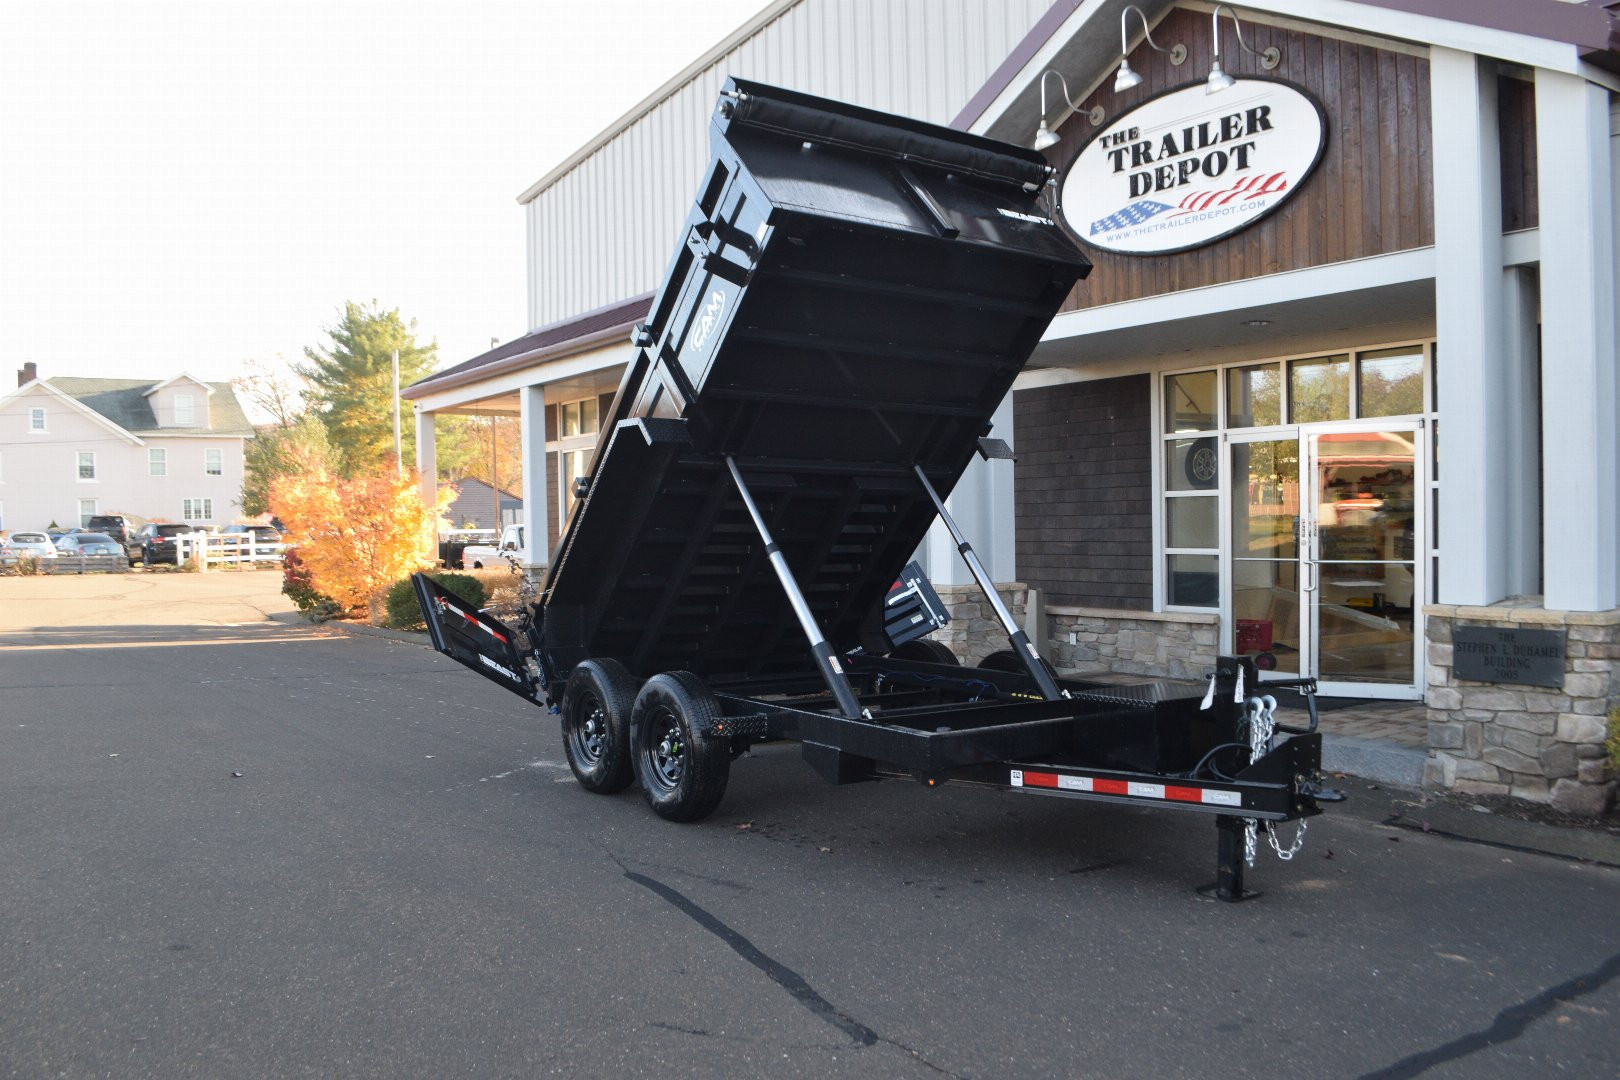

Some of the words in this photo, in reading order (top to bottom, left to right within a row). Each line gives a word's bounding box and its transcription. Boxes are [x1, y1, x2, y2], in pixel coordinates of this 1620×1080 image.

[1099, 126, 1140, 149] THE
[1107, 105, 1274, 174] TRAILER
[1128, 140, 1257, 200] DEPOT
[1106, 199, 1267, 243] WWW.THETRAILERDEPOT.COM
[694, 292, 723, 348] CAM
[1498, 632, 1515, 642] THE
[1457, 641, 1498, 654] STEPHEN
[1513, 645, 1561, 658] DUHAMEL
[1484, 656, 1530, 669] BUILDING
[1495, 669, 1519, 680] 2005
